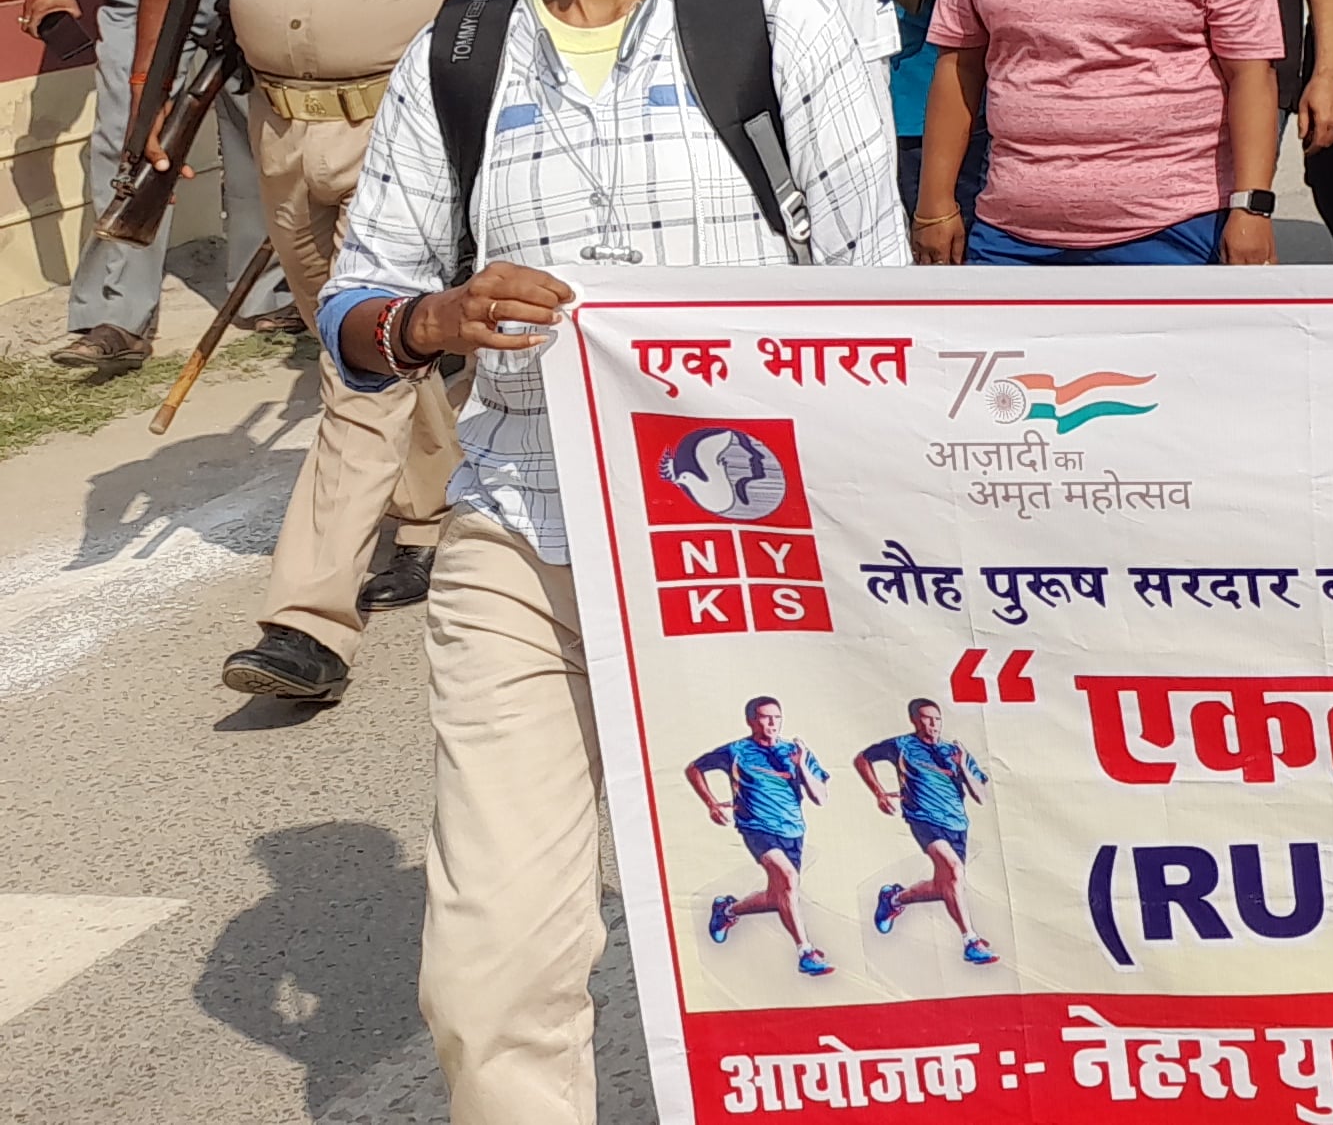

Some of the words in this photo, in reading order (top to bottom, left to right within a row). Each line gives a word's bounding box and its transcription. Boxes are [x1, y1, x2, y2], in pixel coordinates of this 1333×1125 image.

[451, 18, 479, 62] TOMMY
[632, 340, 731, 397] एक
[758, 339, 912, 386] भारत
[926, 430, 1050, 475] आज़ादी
[1053, 451, 1084, 471] का
[968, 481, 1052, 519] अमृत
[1061, 470, 1192, 514] महोत्सव
[860, 540, 963, 611] लौह
[1128, 568, 1300, 609] सरदार
[721, 1036, 979, 1112] आयोजक
